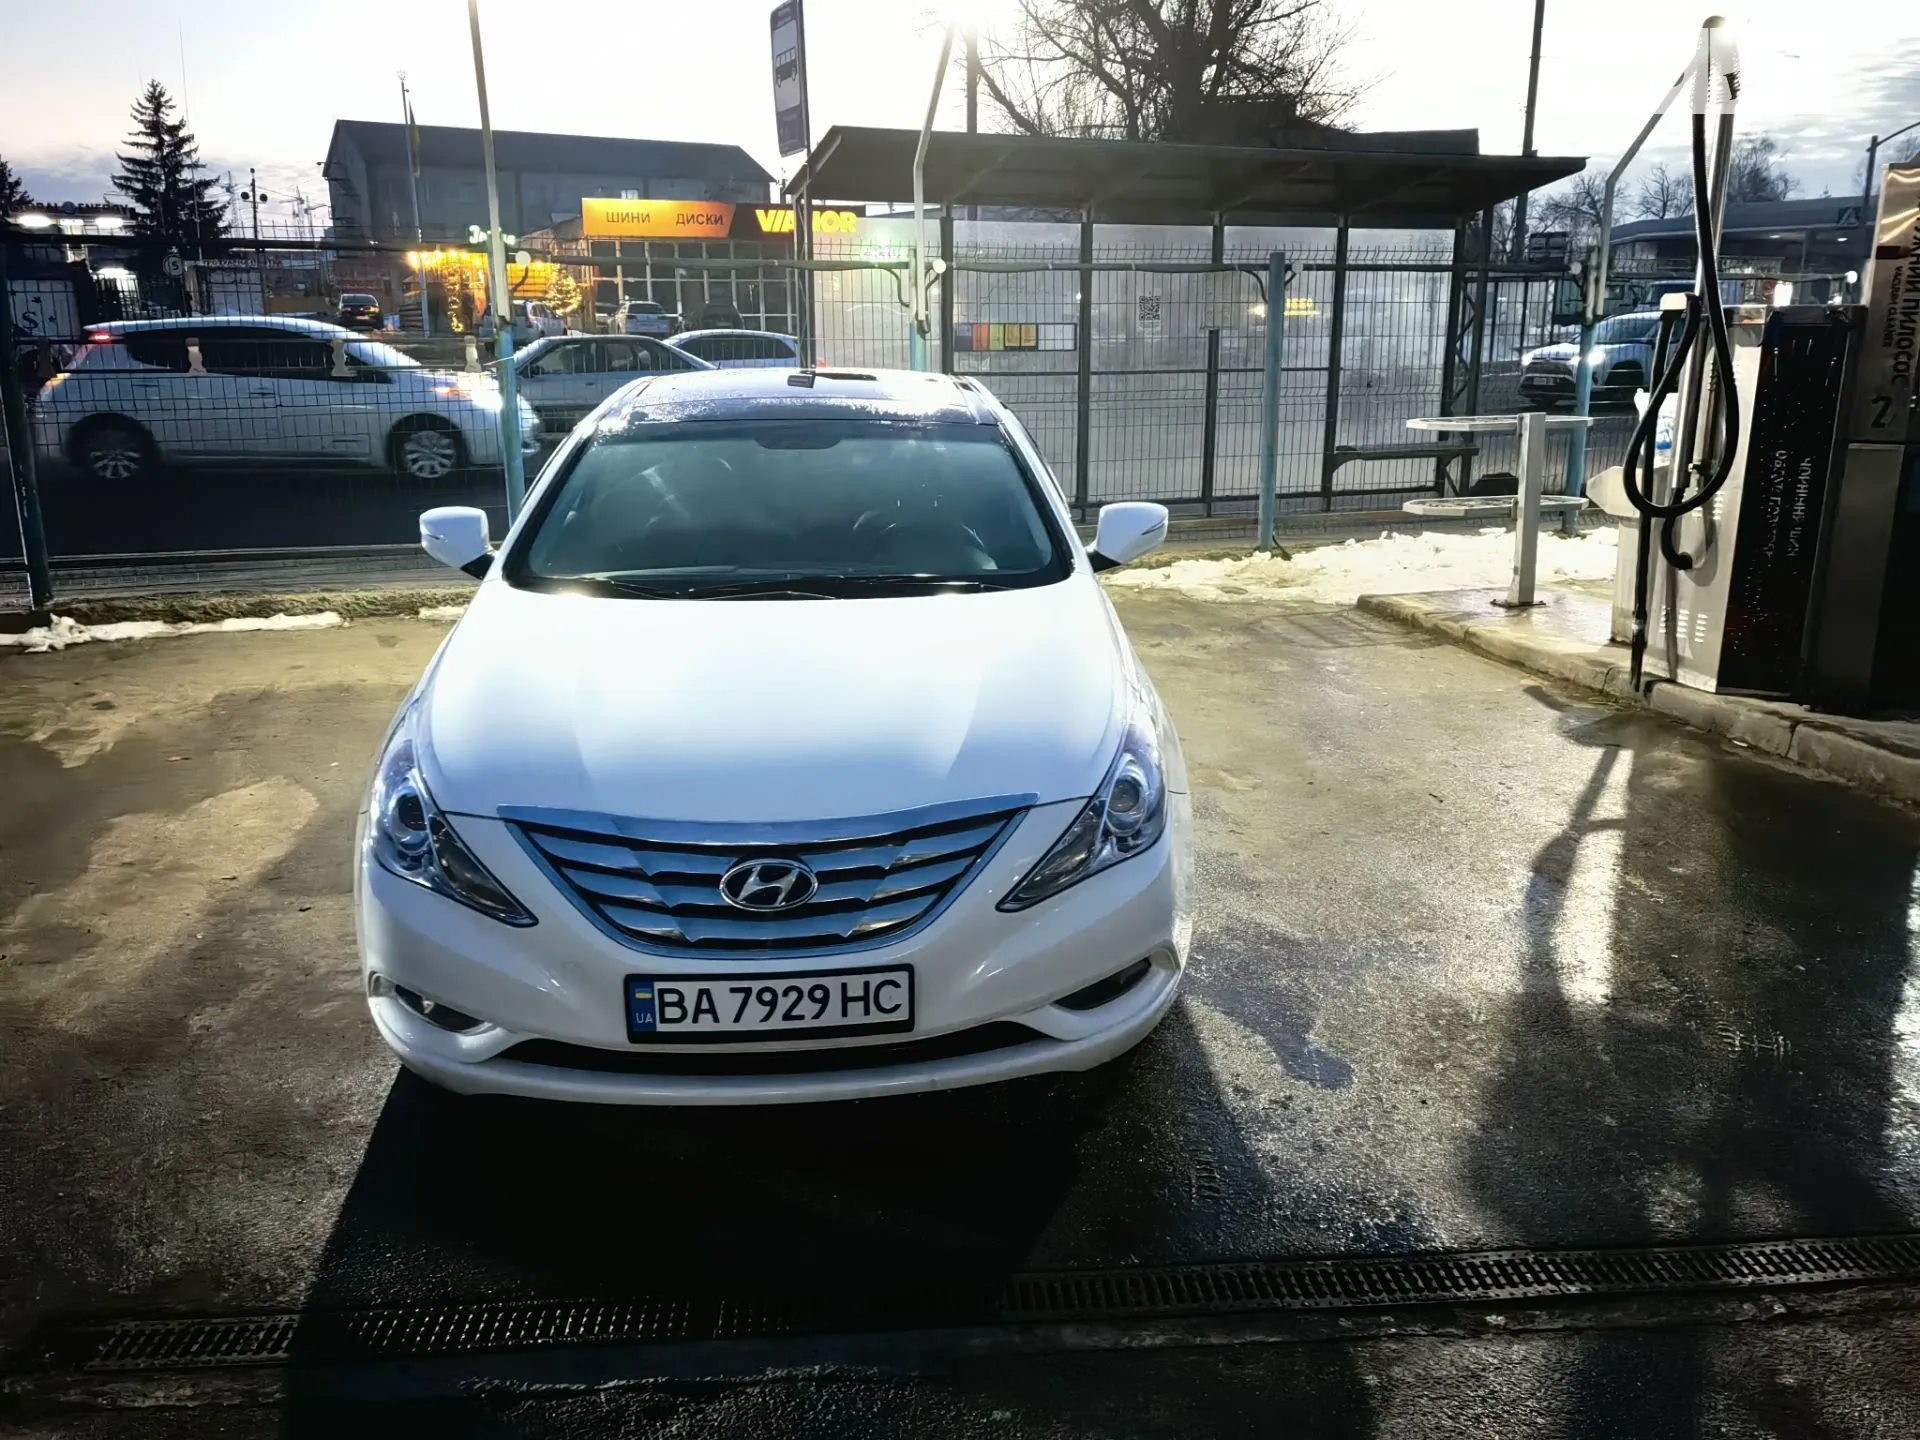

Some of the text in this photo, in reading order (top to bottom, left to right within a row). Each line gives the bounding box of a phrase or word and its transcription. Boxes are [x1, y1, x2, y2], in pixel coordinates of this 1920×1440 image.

[606, 211, 724, 226] ШИНИ ДИСКИ
[1891, 298, 1920, 385] ПИЛОСОС
[1871, 396, 1893, 428] 2
[657, 979, 902, 1024] BA 7929 HC
[635, 1012, 654, 1024] UA
